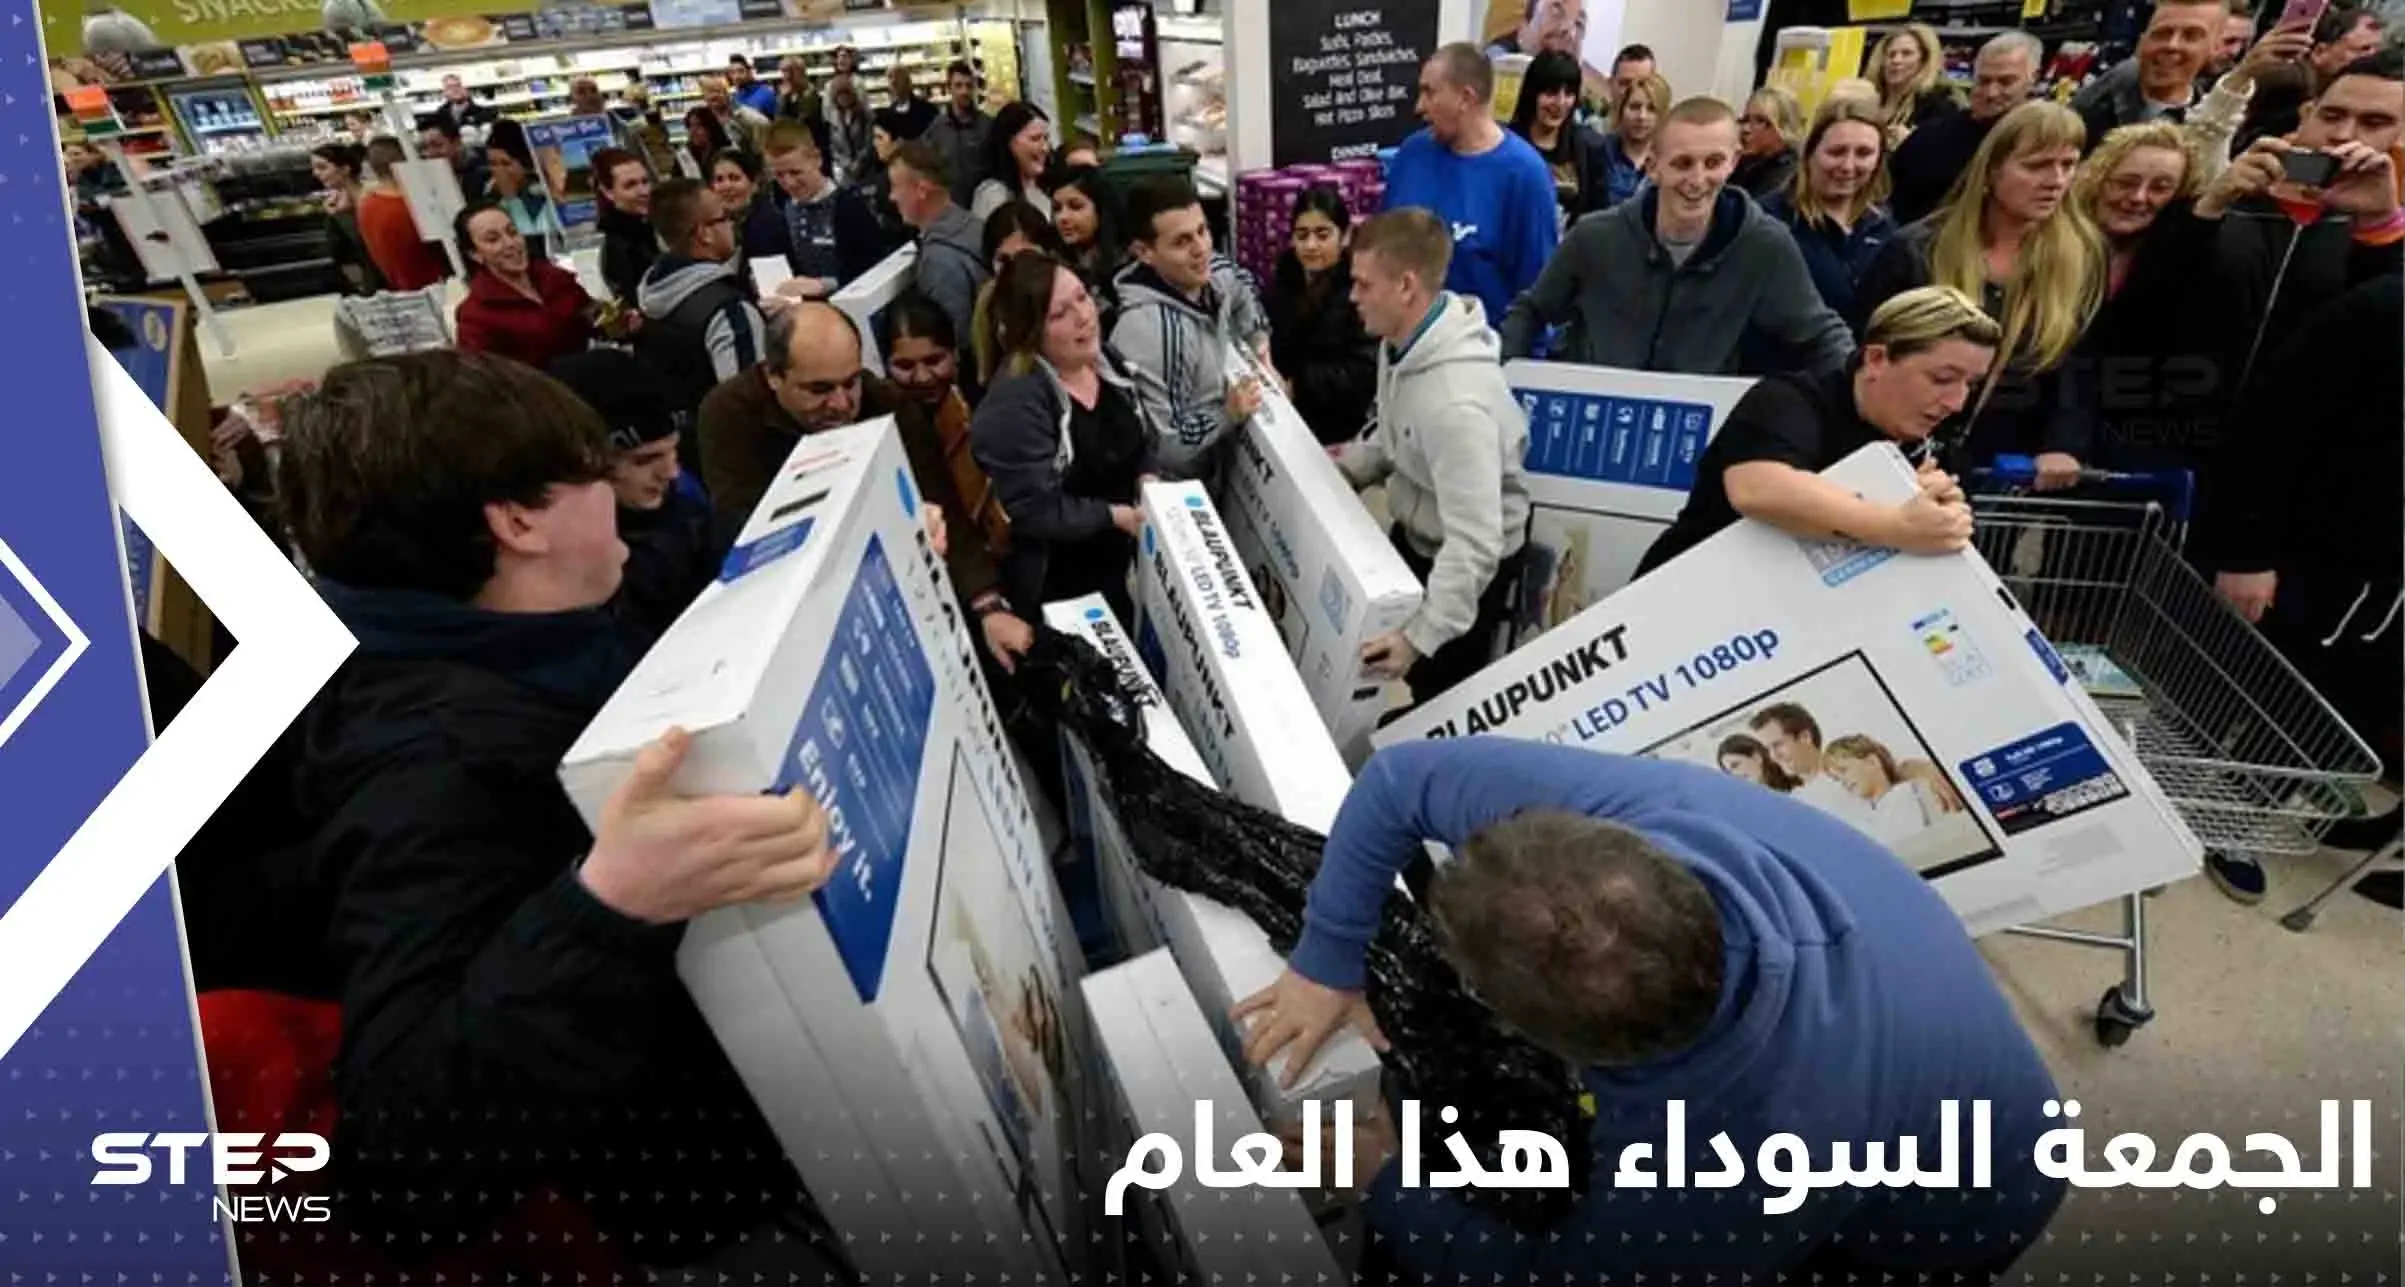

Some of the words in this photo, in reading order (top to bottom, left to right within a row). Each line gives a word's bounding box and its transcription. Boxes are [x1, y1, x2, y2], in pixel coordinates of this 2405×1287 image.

[1335, 10, 1381, 28] LUNCH
[1191, 509, 1255, 611] BLAUPUNKT
[1571, 698, 1629, 741] LED
[1627, 677, 1671, 712] TV
[1675, 628, 1780, 689] 1080p
[799, 738, 856, 854] Enjoy
